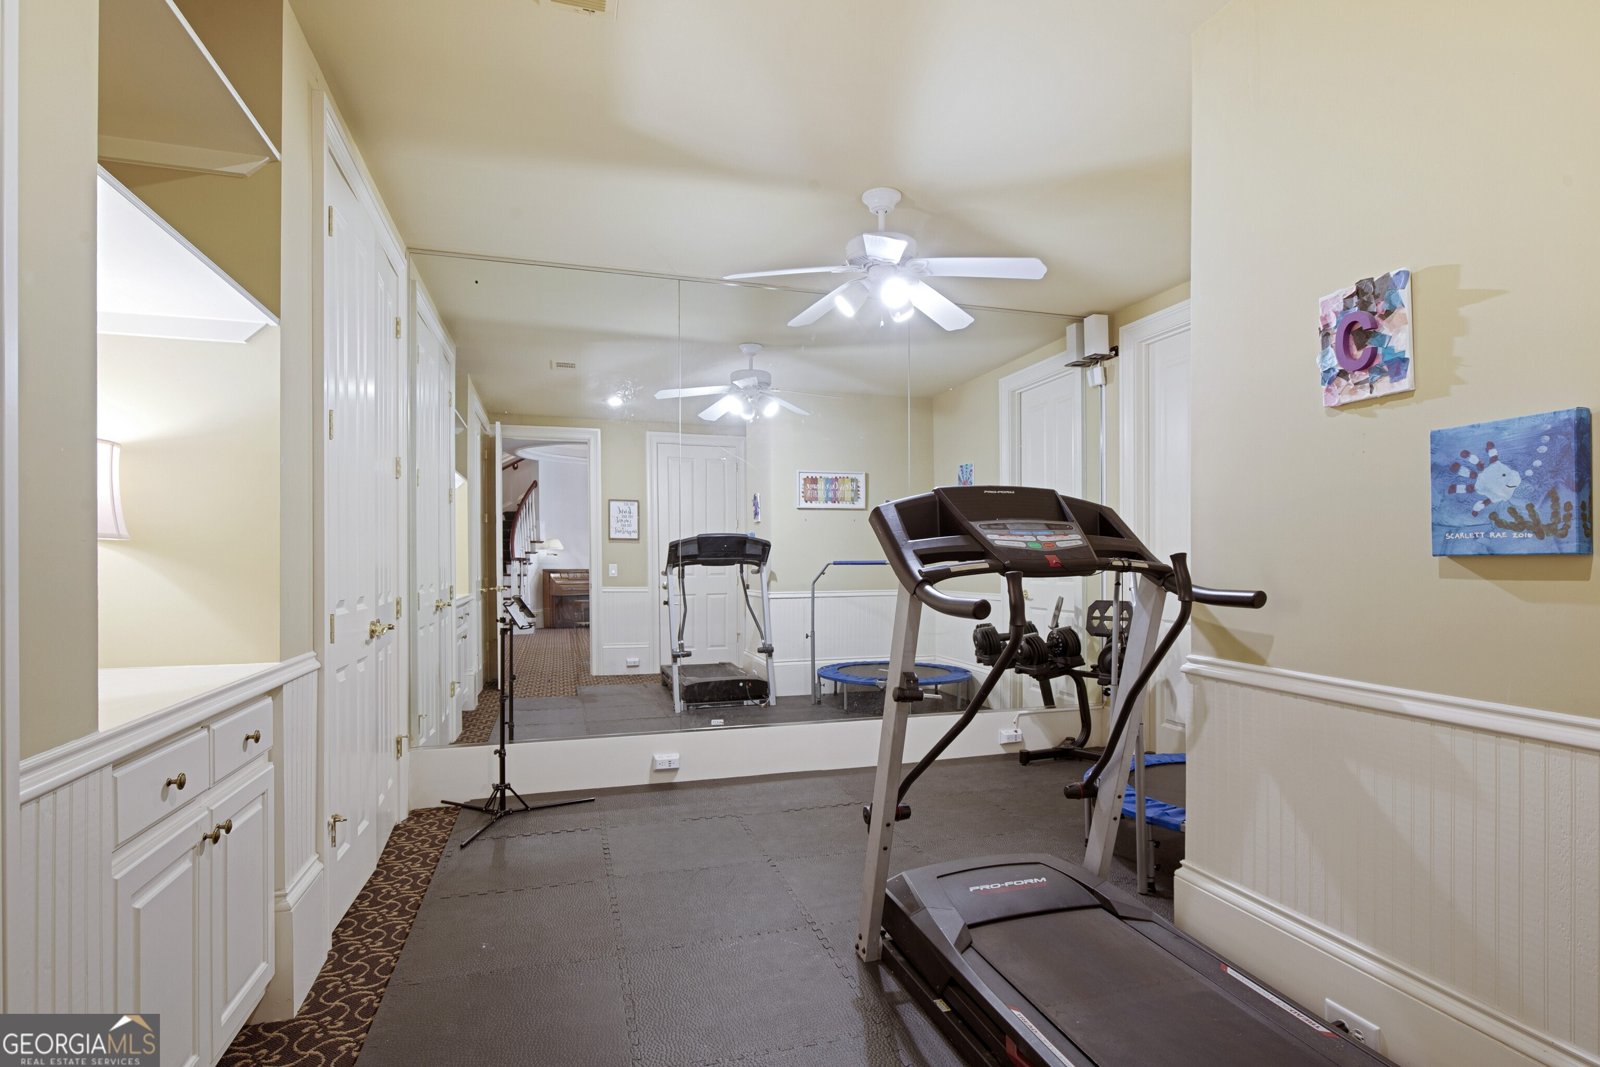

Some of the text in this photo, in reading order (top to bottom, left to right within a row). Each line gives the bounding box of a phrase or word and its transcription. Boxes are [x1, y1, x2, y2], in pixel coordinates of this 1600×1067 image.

[1335, 310, 1378, 372] C
[1445, 531, 1484, 540] SCARLETT
[1489, 531, 1508, 539] RAE
[968, 877, 1047, 892] PRO-FORM
